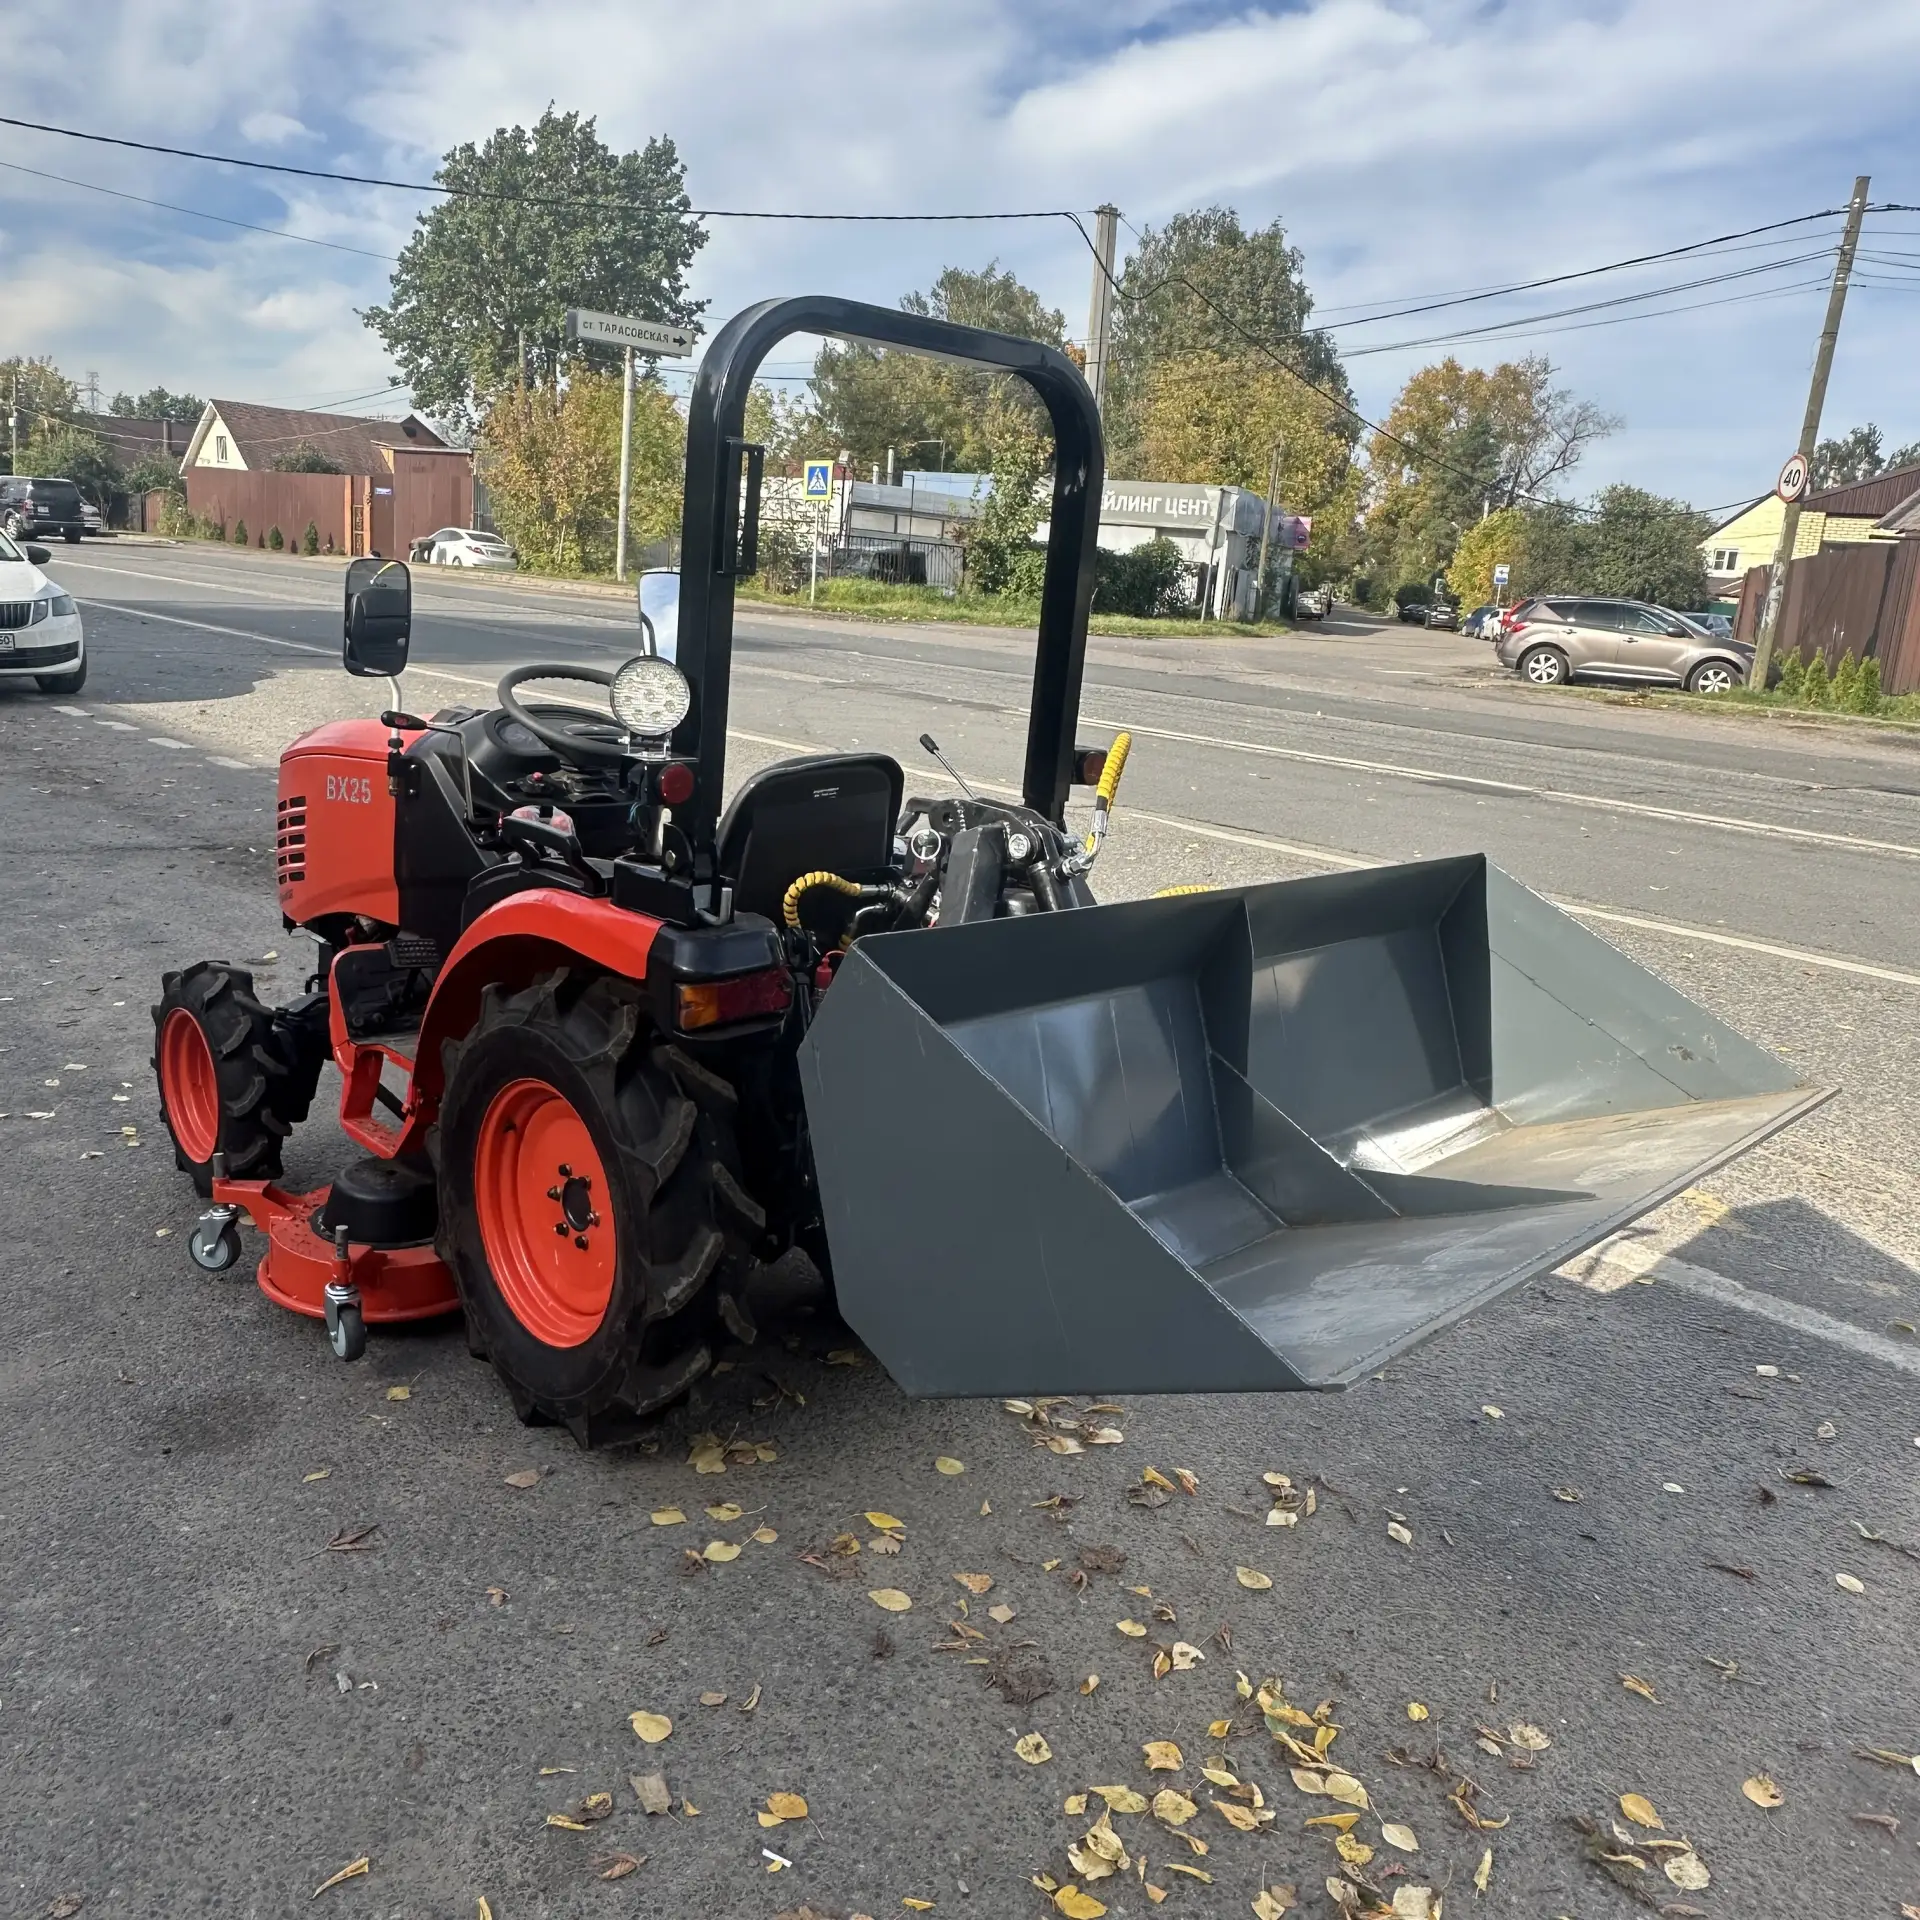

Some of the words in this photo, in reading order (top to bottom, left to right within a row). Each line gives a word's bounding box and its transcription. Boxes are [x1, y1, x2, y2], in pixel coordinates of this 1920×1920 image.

[599, 321, 669, 343] ТАРАСОВСКАЯ
[1783, 468, 1801, 487] 40
[1101, 489, 1162, 513] ЙЛИНГ
[326, 774, 372, 804] BX25
